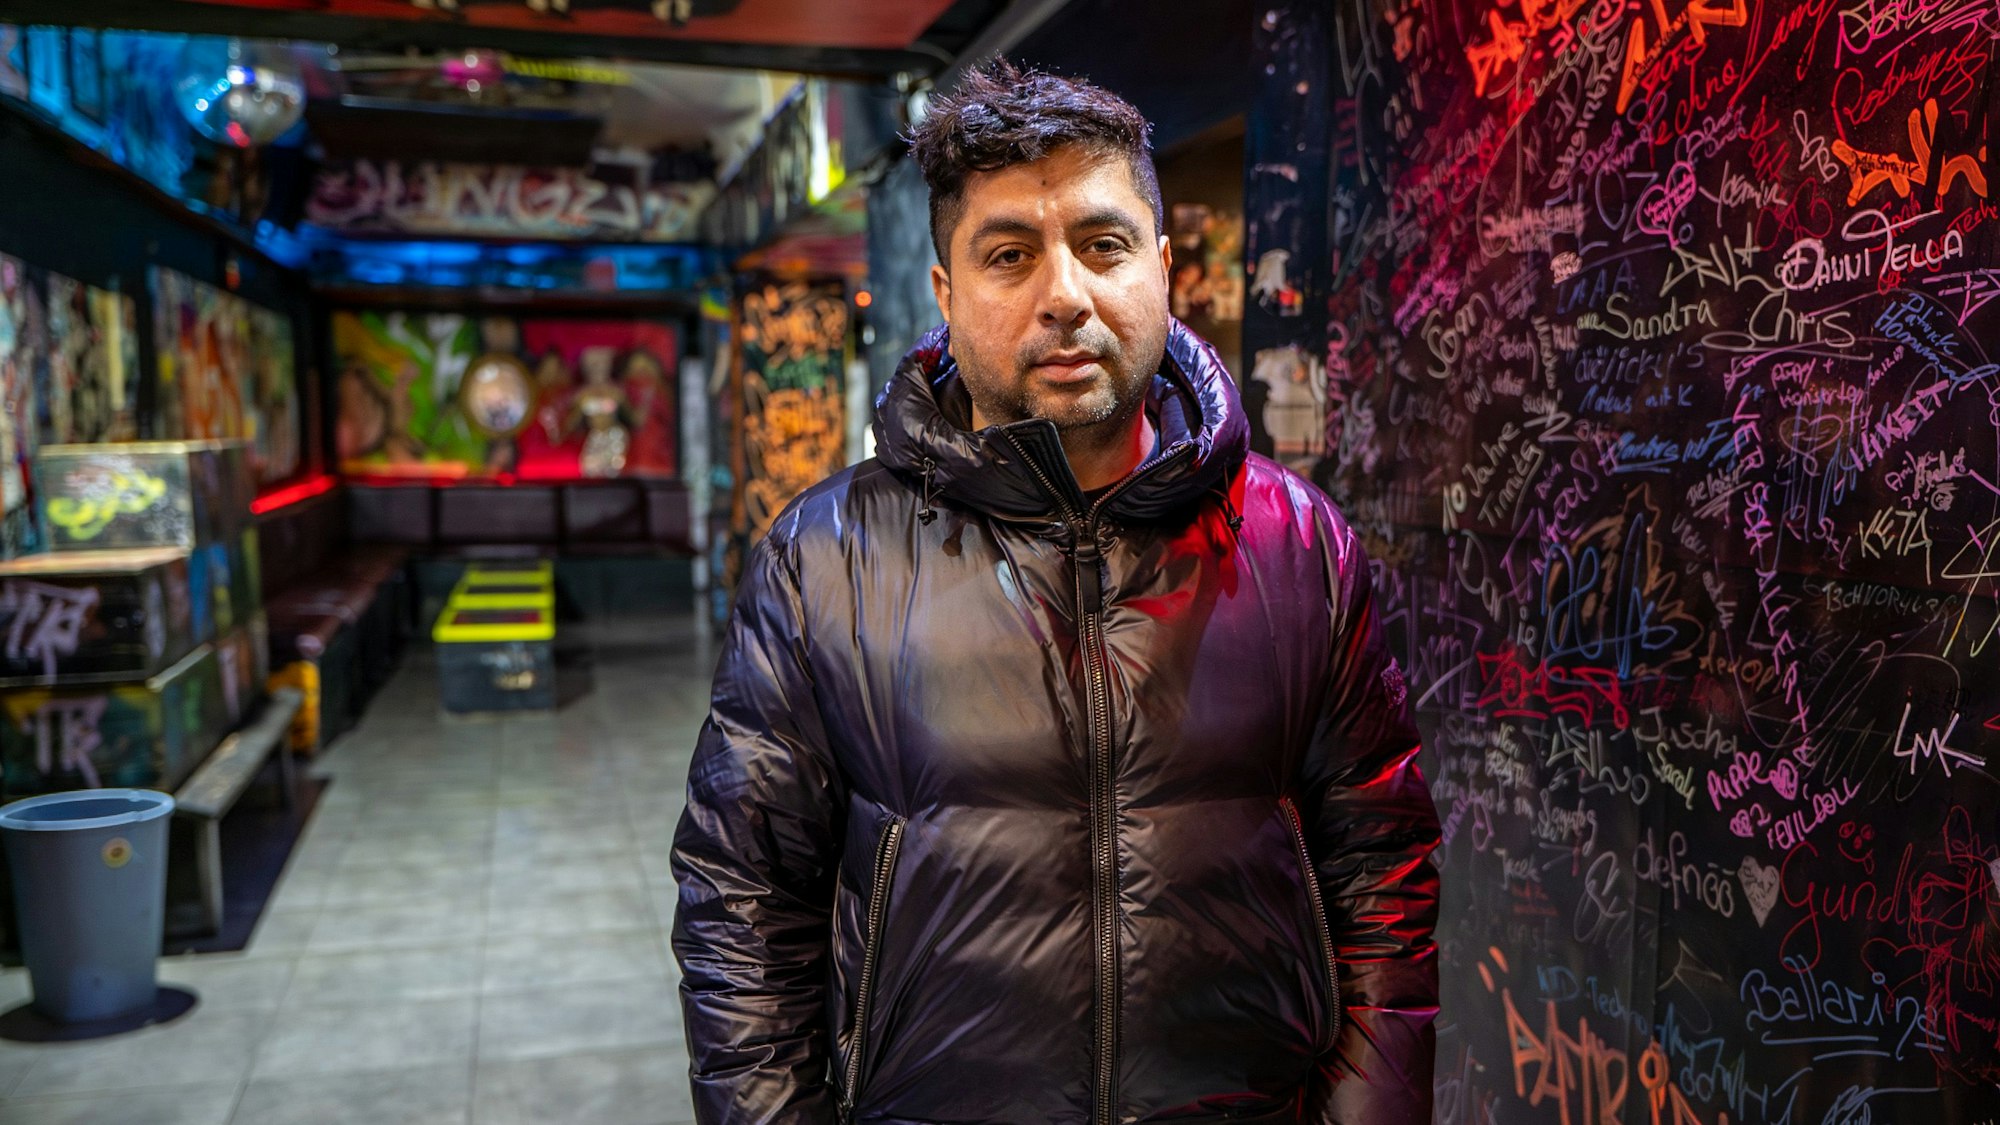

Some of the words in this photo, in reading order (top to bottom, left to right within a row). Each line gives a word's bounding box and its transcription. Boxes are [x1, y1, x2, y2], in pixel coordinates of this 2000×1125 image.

[1600, 292, 1719, 341] Sandra
[1749, 288, 1856, 348] Chris
[1858, 505, 1934, 586] KETA
